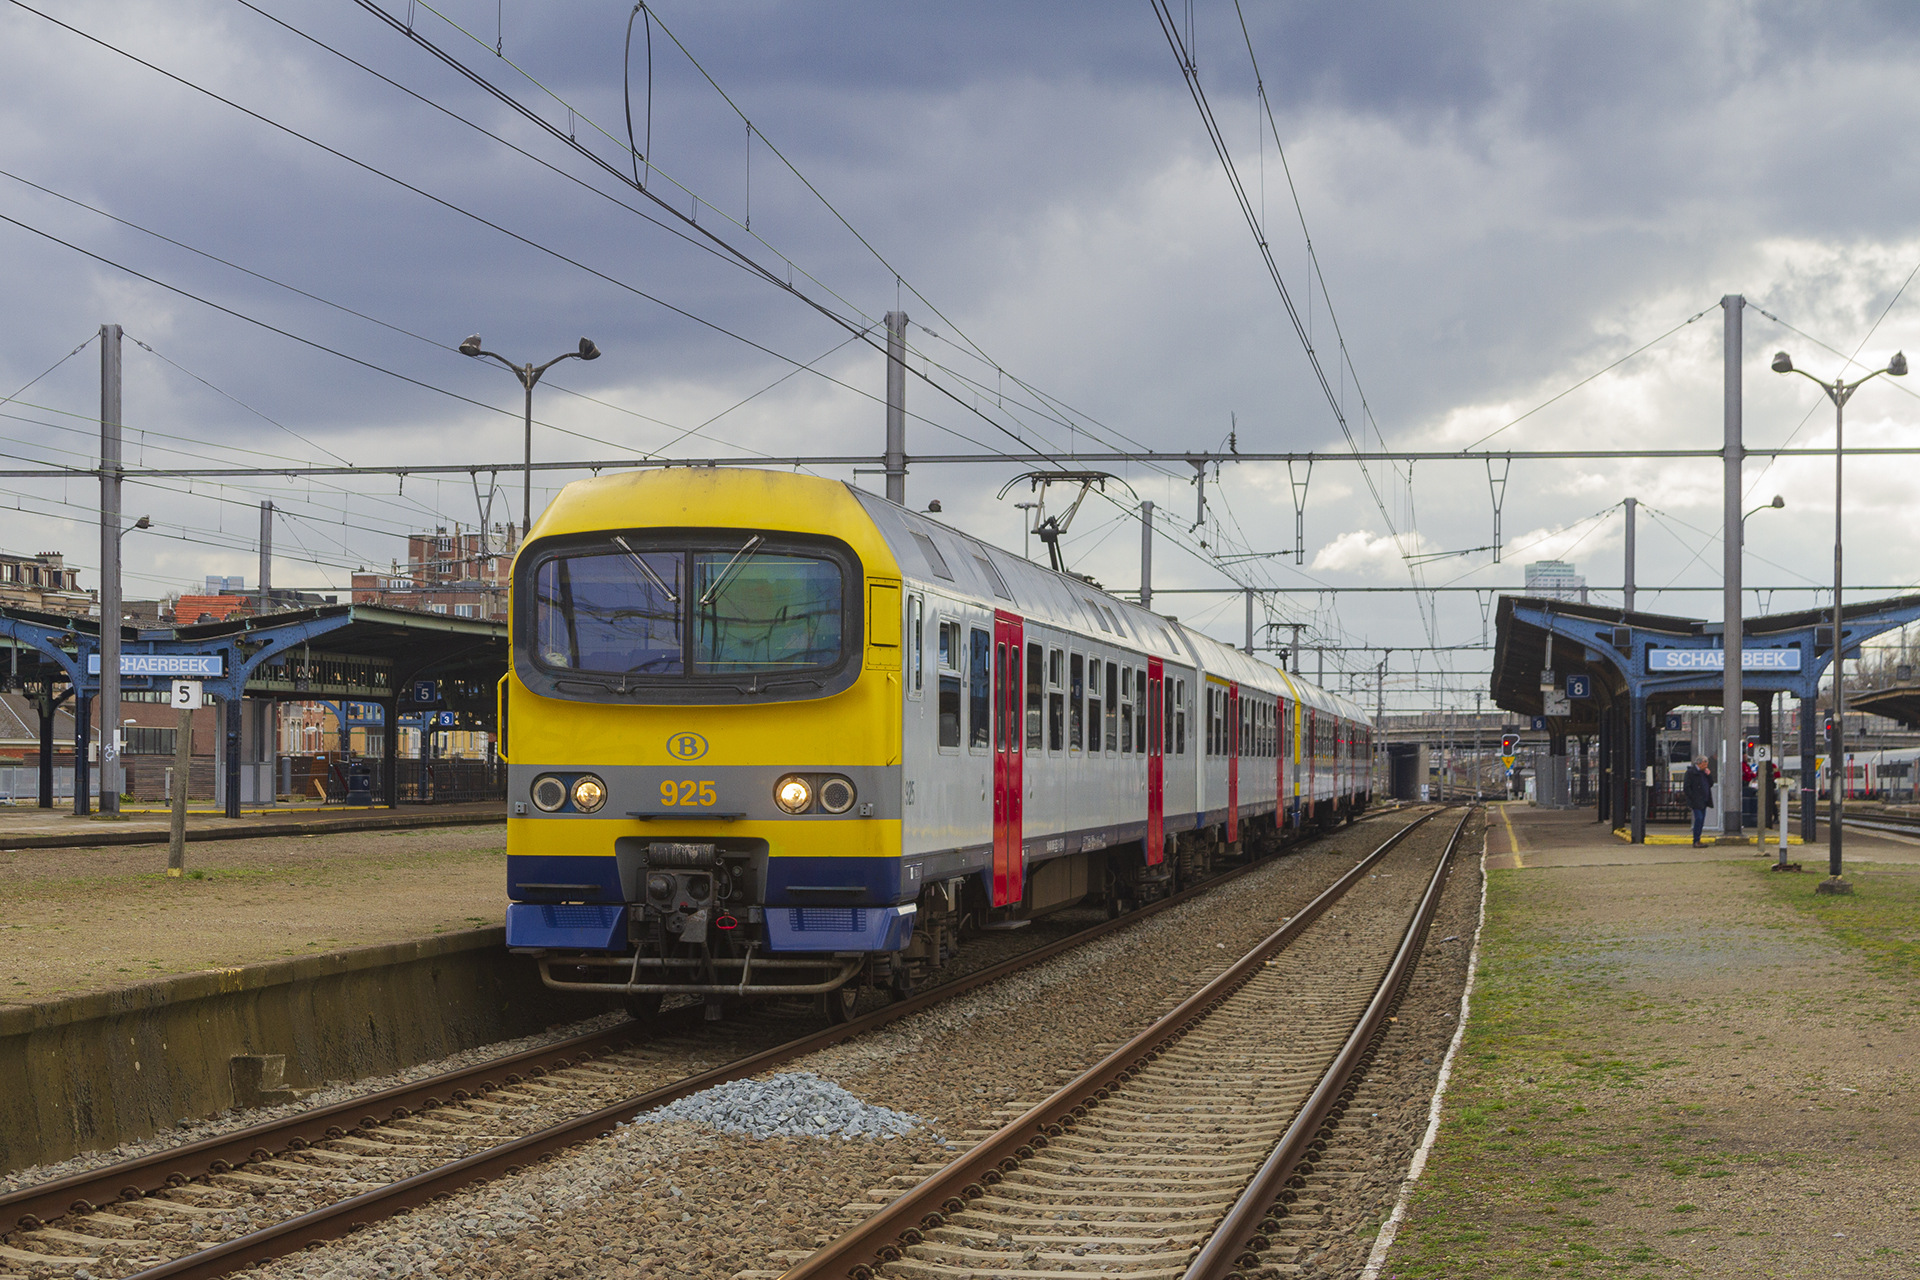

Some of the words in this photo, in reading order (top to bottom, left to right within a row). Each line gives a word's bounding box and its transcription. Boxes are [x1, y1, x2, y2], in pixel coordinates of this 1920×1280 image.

[119, 656, 210, 673] HAERBEEK
[1665, 651, 1787, 667] SCHAEBEEK
[179, 685, 191, 703] 5
[420, 688, 430, 700] 5
[1574, 682, 1583, 695] 8
[443, 716, 450, 724] 3
[1536, 720, 1542, 729] 8
[1670, 719, 1677, 728] 9
[1758, 747, 1766, 757] 9
[660, 780, 717, 806] 925
